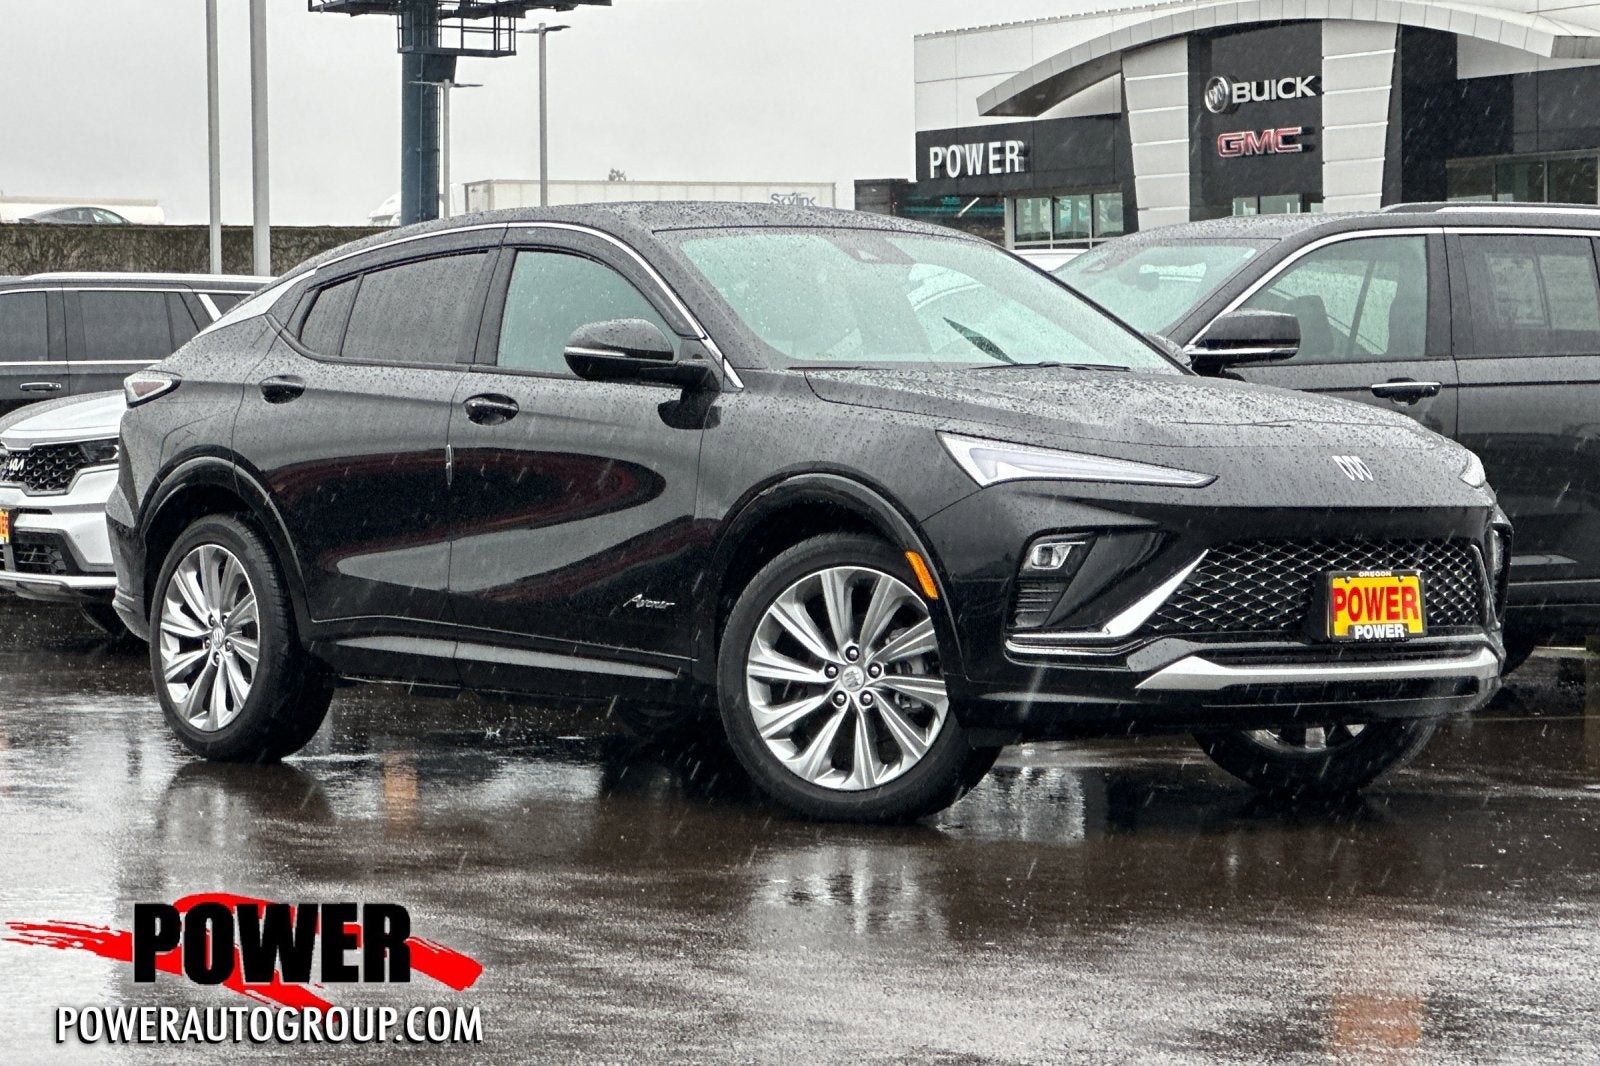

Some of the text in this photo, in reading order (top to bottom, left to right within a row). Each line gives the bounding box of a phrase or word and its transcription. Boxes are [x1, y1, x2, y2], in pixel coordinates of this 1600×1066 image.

[1232, 75, 1316, 104] BUICK
[1217, 126, 1302, 157] GMC
[929, 139, 1024, 179] POWER
[1333, 586, 1419, 623] POWER
[1354, 623, 1405, 640] POWER
